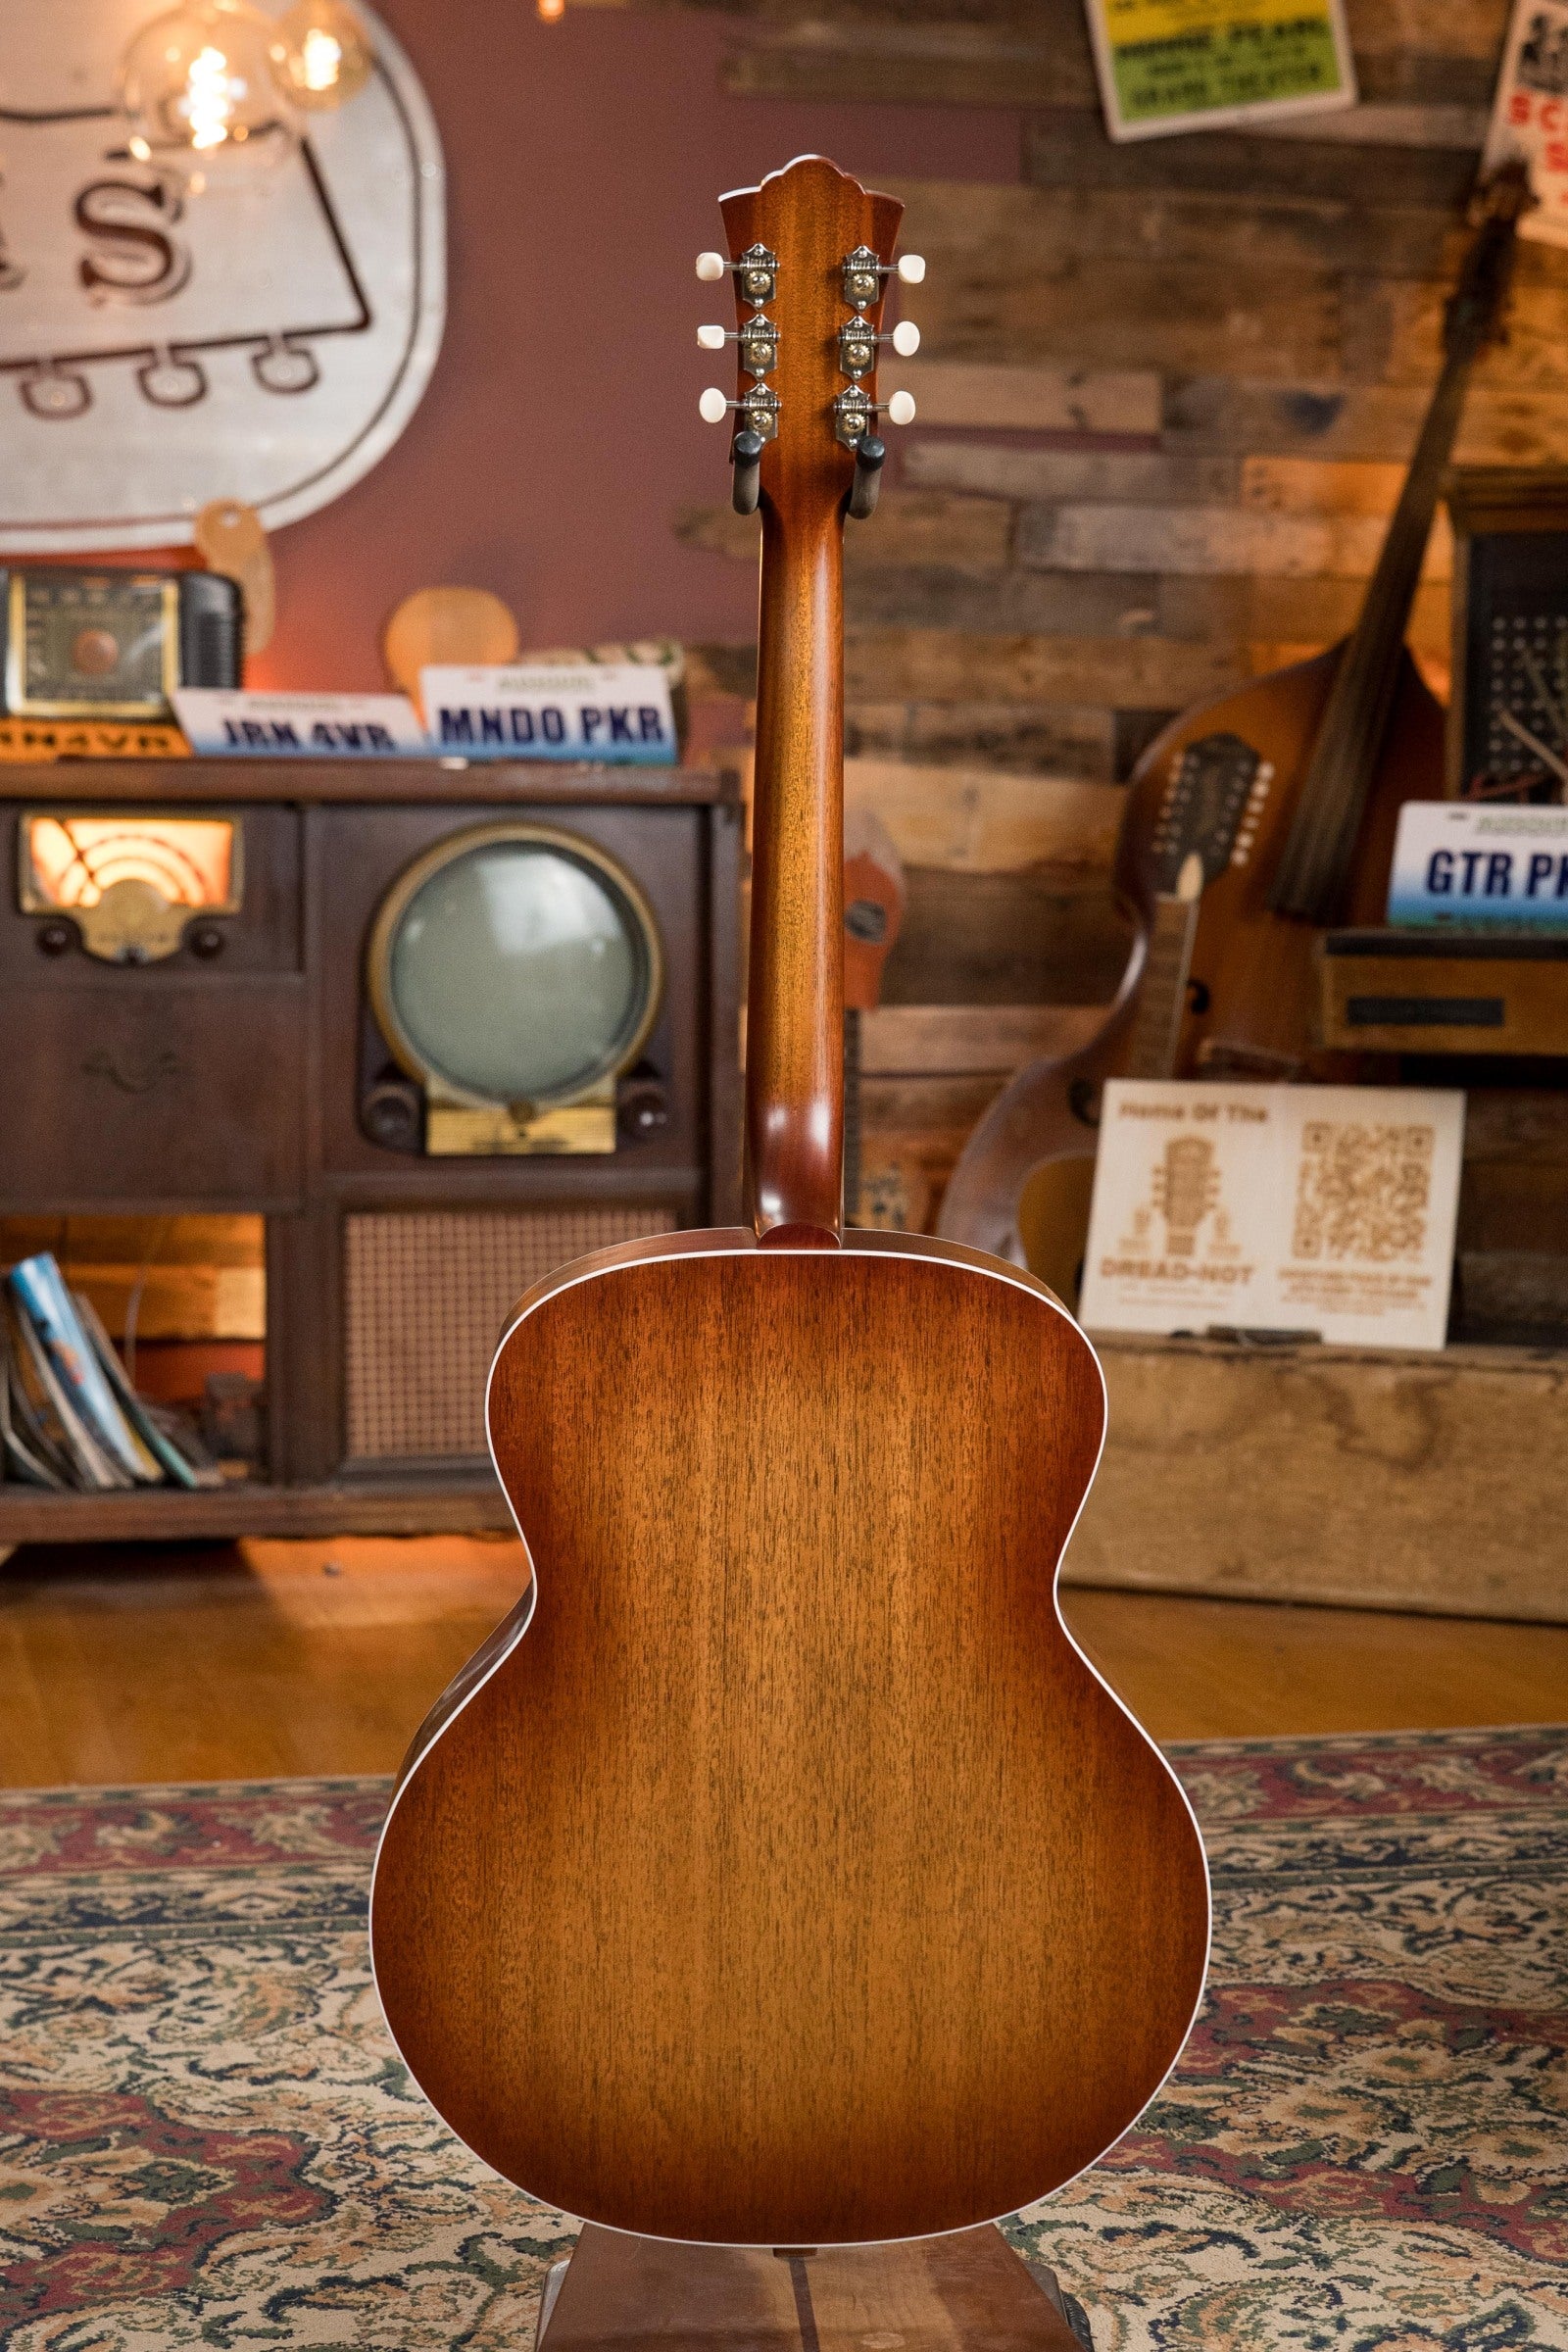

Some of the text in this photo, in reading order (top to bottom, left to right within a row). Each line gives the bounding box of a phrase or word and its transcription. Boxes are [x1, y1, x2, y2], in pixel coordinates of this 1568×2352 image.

[439, 706, 663, 744] MNDO PKR
[1426, 850, 1514, 896] GTR
